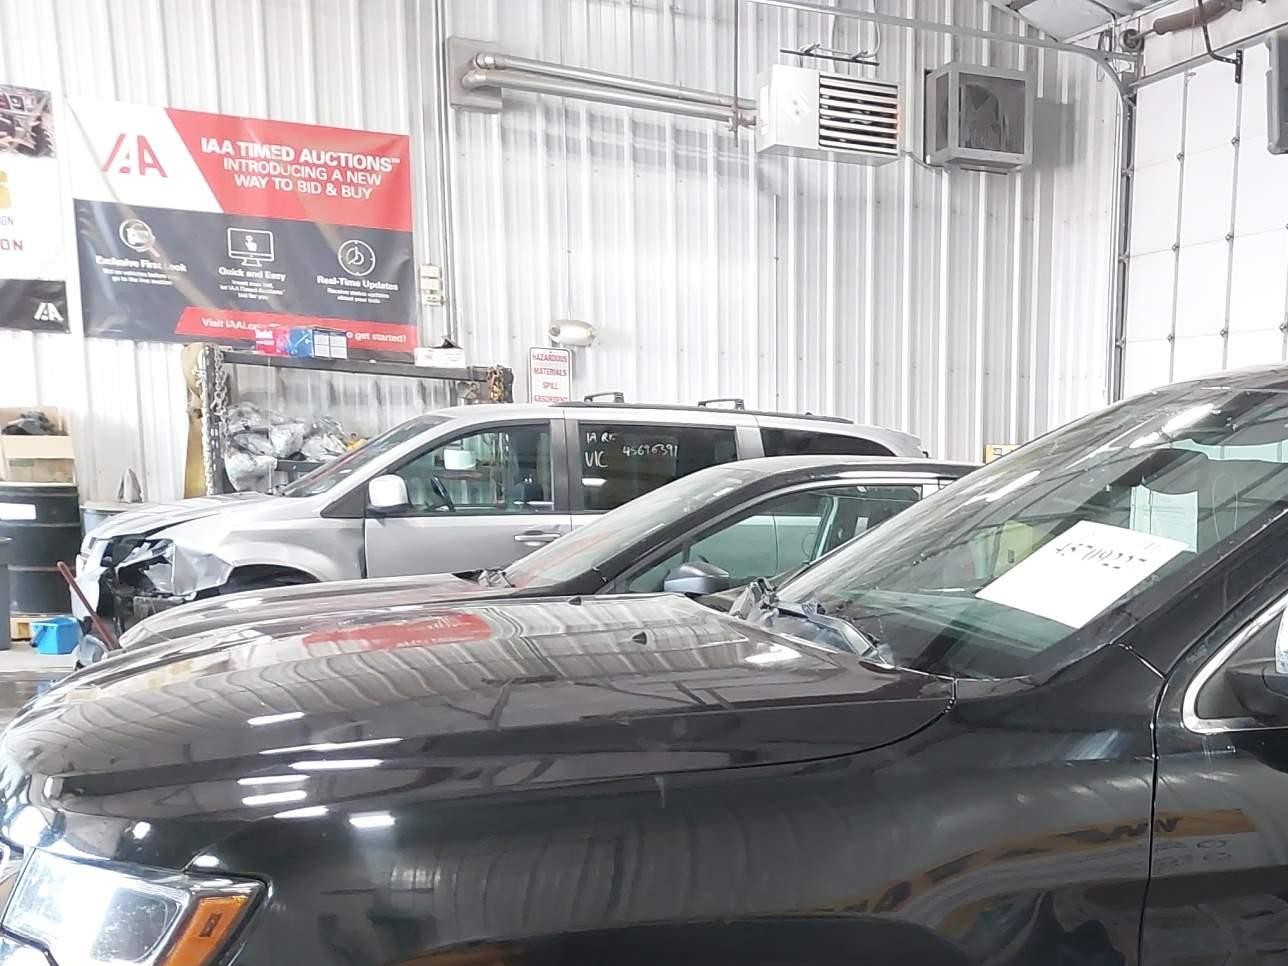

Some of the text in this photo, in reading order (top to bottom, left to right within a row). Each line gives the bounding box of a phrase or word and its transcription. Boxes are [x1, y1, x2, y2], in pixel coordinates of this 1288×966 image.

[201, 137, 235, 155] IAA
[237, 141, 295, 161] TIMED
[223, 157, 381, 185] INTRODUCING A NEW
[234, 174, 373, 199] WAY TO BID & BUY
[219, 266, 286, 282] Quick and Easy
[316, 275, 399, 291] Real-Time Updates
[202, 318, 224, 328] Visit
[355, 333, 370, 342] get
[372, 333, 407, 344] started!
[533, 368, 567, 376] MATERIALS
[543, 382, 560, 390] SPILL
